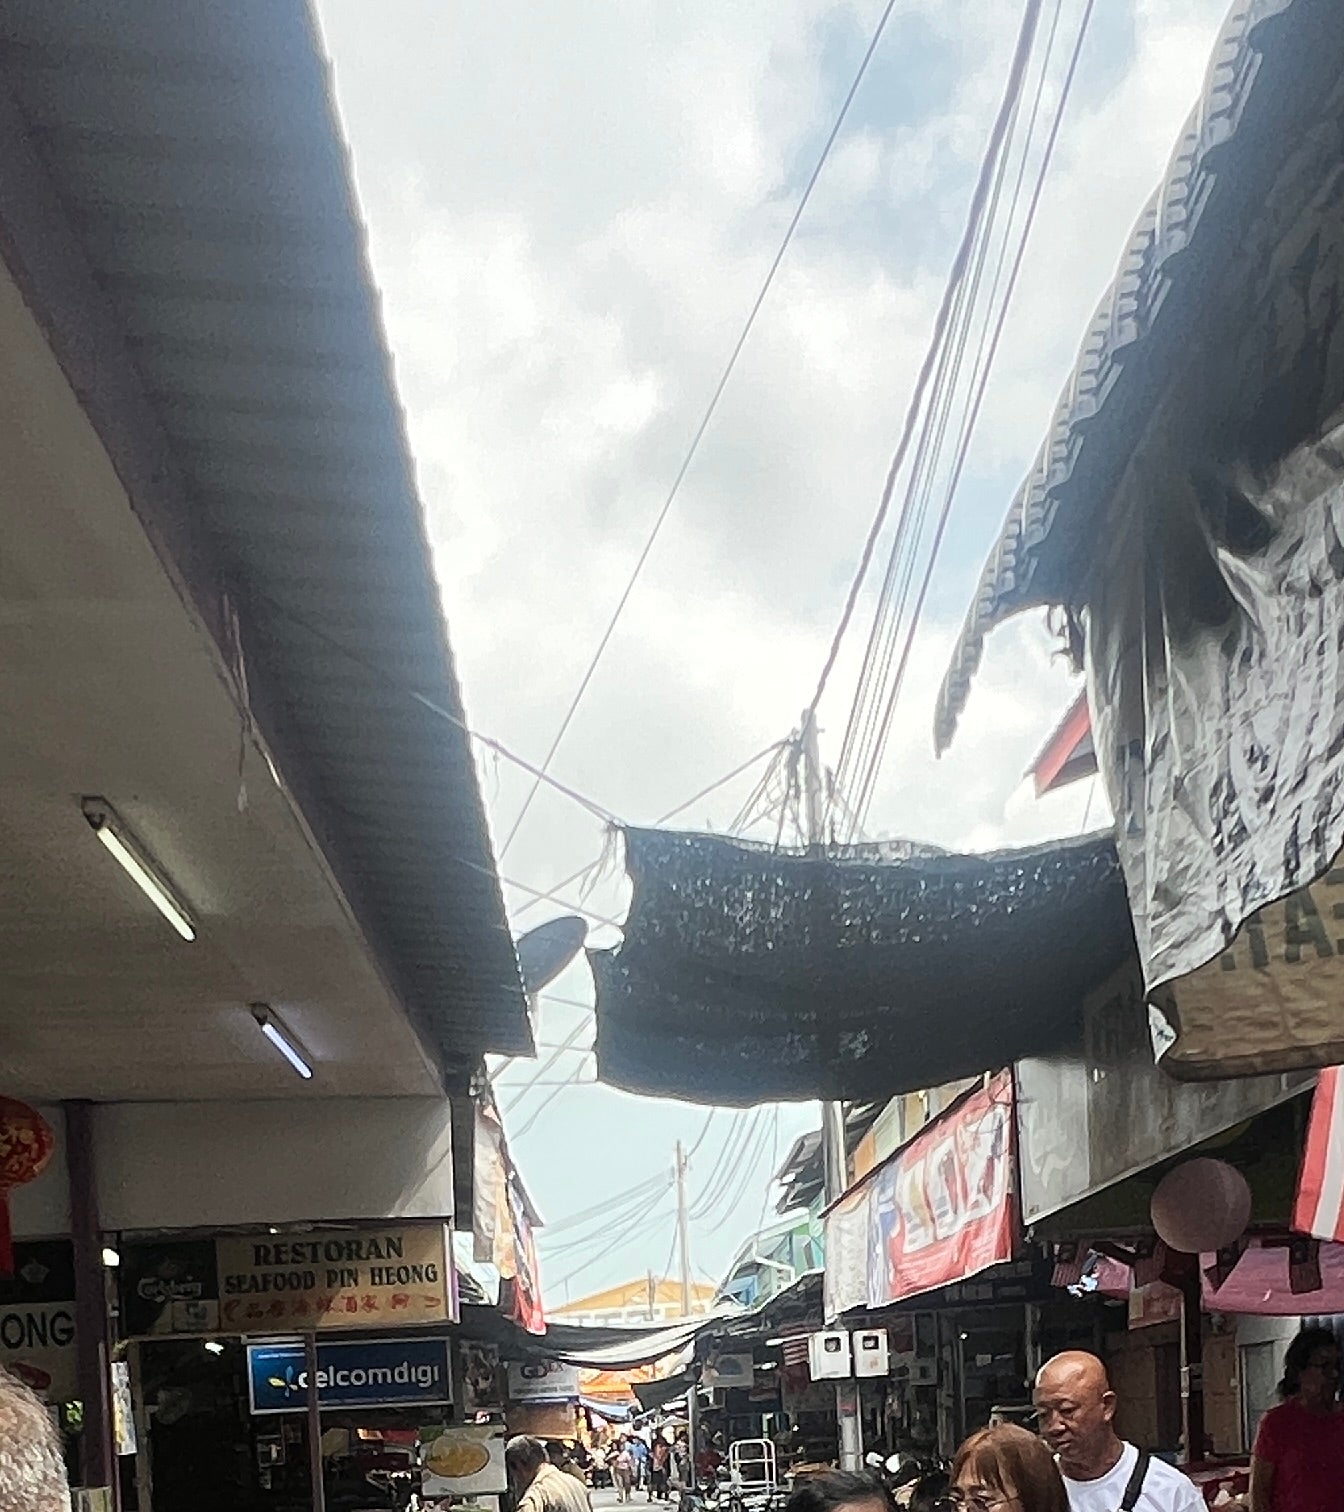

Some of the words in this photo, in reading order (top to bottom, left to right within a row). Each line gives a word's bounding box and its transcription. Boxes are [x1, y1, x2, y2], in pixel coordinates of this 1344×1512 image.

[254, 1236, 405, 1267] RESTORAN
[225, 1269, 317, 1295] SEAFOOD
[326, 1267, 359, 1290] PIN
[370, 1263, 439, 1287] HEONG
[297, 1360, 440, 1391] celcomdigi
